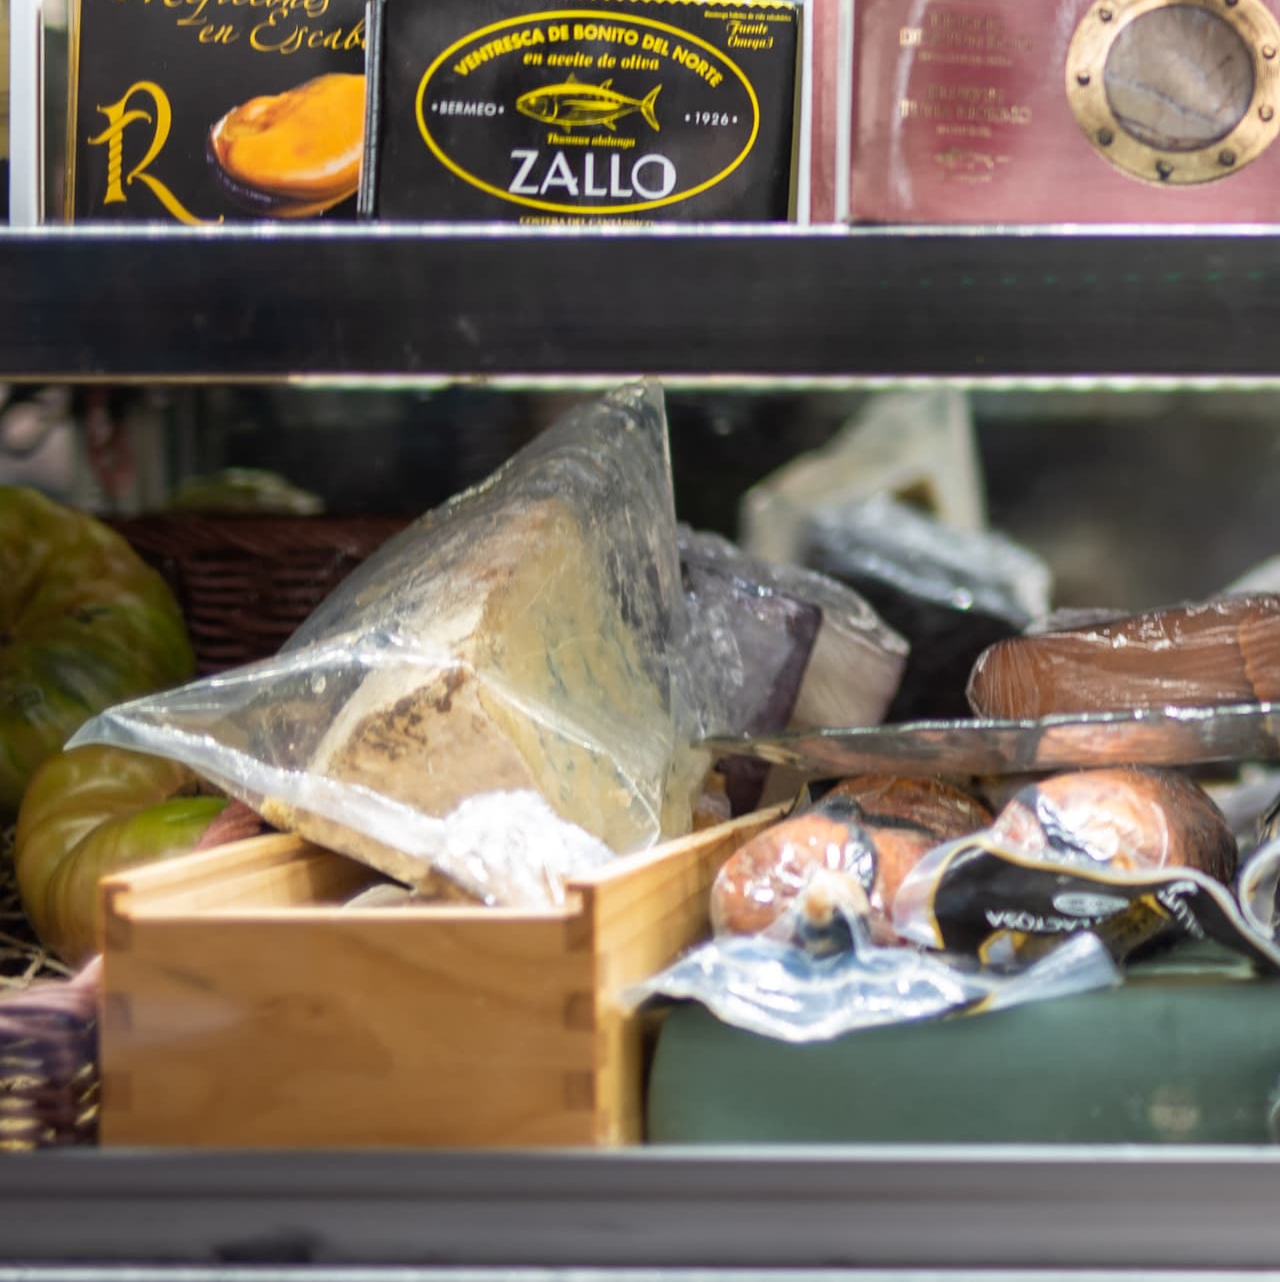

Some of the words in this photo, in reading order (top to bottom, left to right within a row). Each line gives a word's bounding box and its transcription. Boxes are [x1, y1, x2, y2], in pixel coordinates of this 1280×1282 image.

[198, 20, 240, 46] en
[453, 27, 545, 77] VENTRESCA
[548, 24, 569, 42] DE
[573, 24, 640, 46] BONITO
[641, 35, 669, 57] DEL
[671, 45, 725, 89] NORTE
[523, 52, 543, 66] en
[547, 52, 594, 67] aceite
[597, 53, 617, 68] de
[620, 53, 660, 71] oliva
[439, 100, 496, 117] BERMEO
[693, 111, 729, 127] 1926
[509, 148, 677, 201] ZALLO
